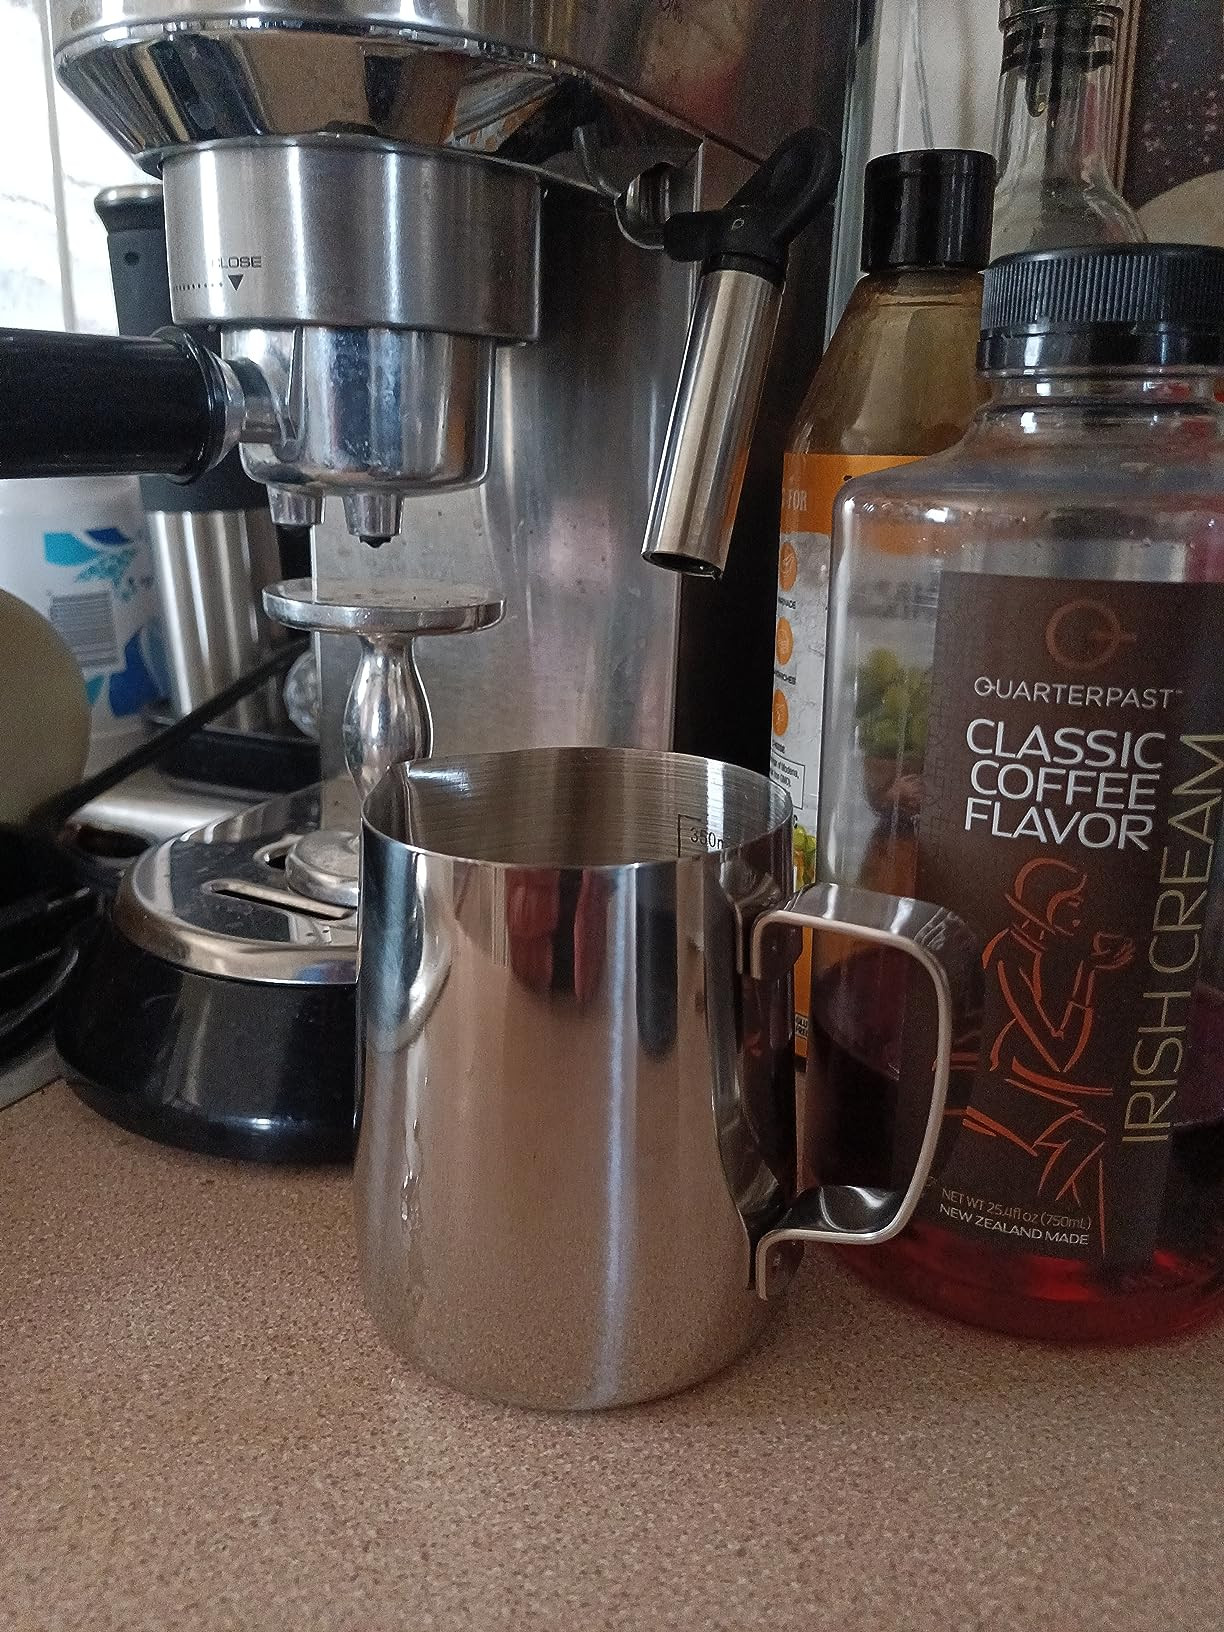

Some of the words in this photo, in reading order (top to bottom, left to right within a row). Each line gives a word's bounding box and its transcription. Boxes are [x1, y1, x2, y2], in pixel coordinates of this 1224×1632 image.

[211, 255, 262, 269] LOSE
[966, 718, 1167, 769] CLASSIC
[970, 760, 1160, 810] COFFEE
[964, 797, 1154, 851] FLAVOR
[1148, 734, 1224, 973] CREAM
[1122, 991, 1191, 1141] IRISH
[939, 1203, 973, 1223] NEW
[975, 1215, 1043, 1239] ZEALAND
[1045, 1231, 1090, 1245] MADE
[942, 1188, 964, 1204] NET
[966, 1195, 985, 1211] WT
